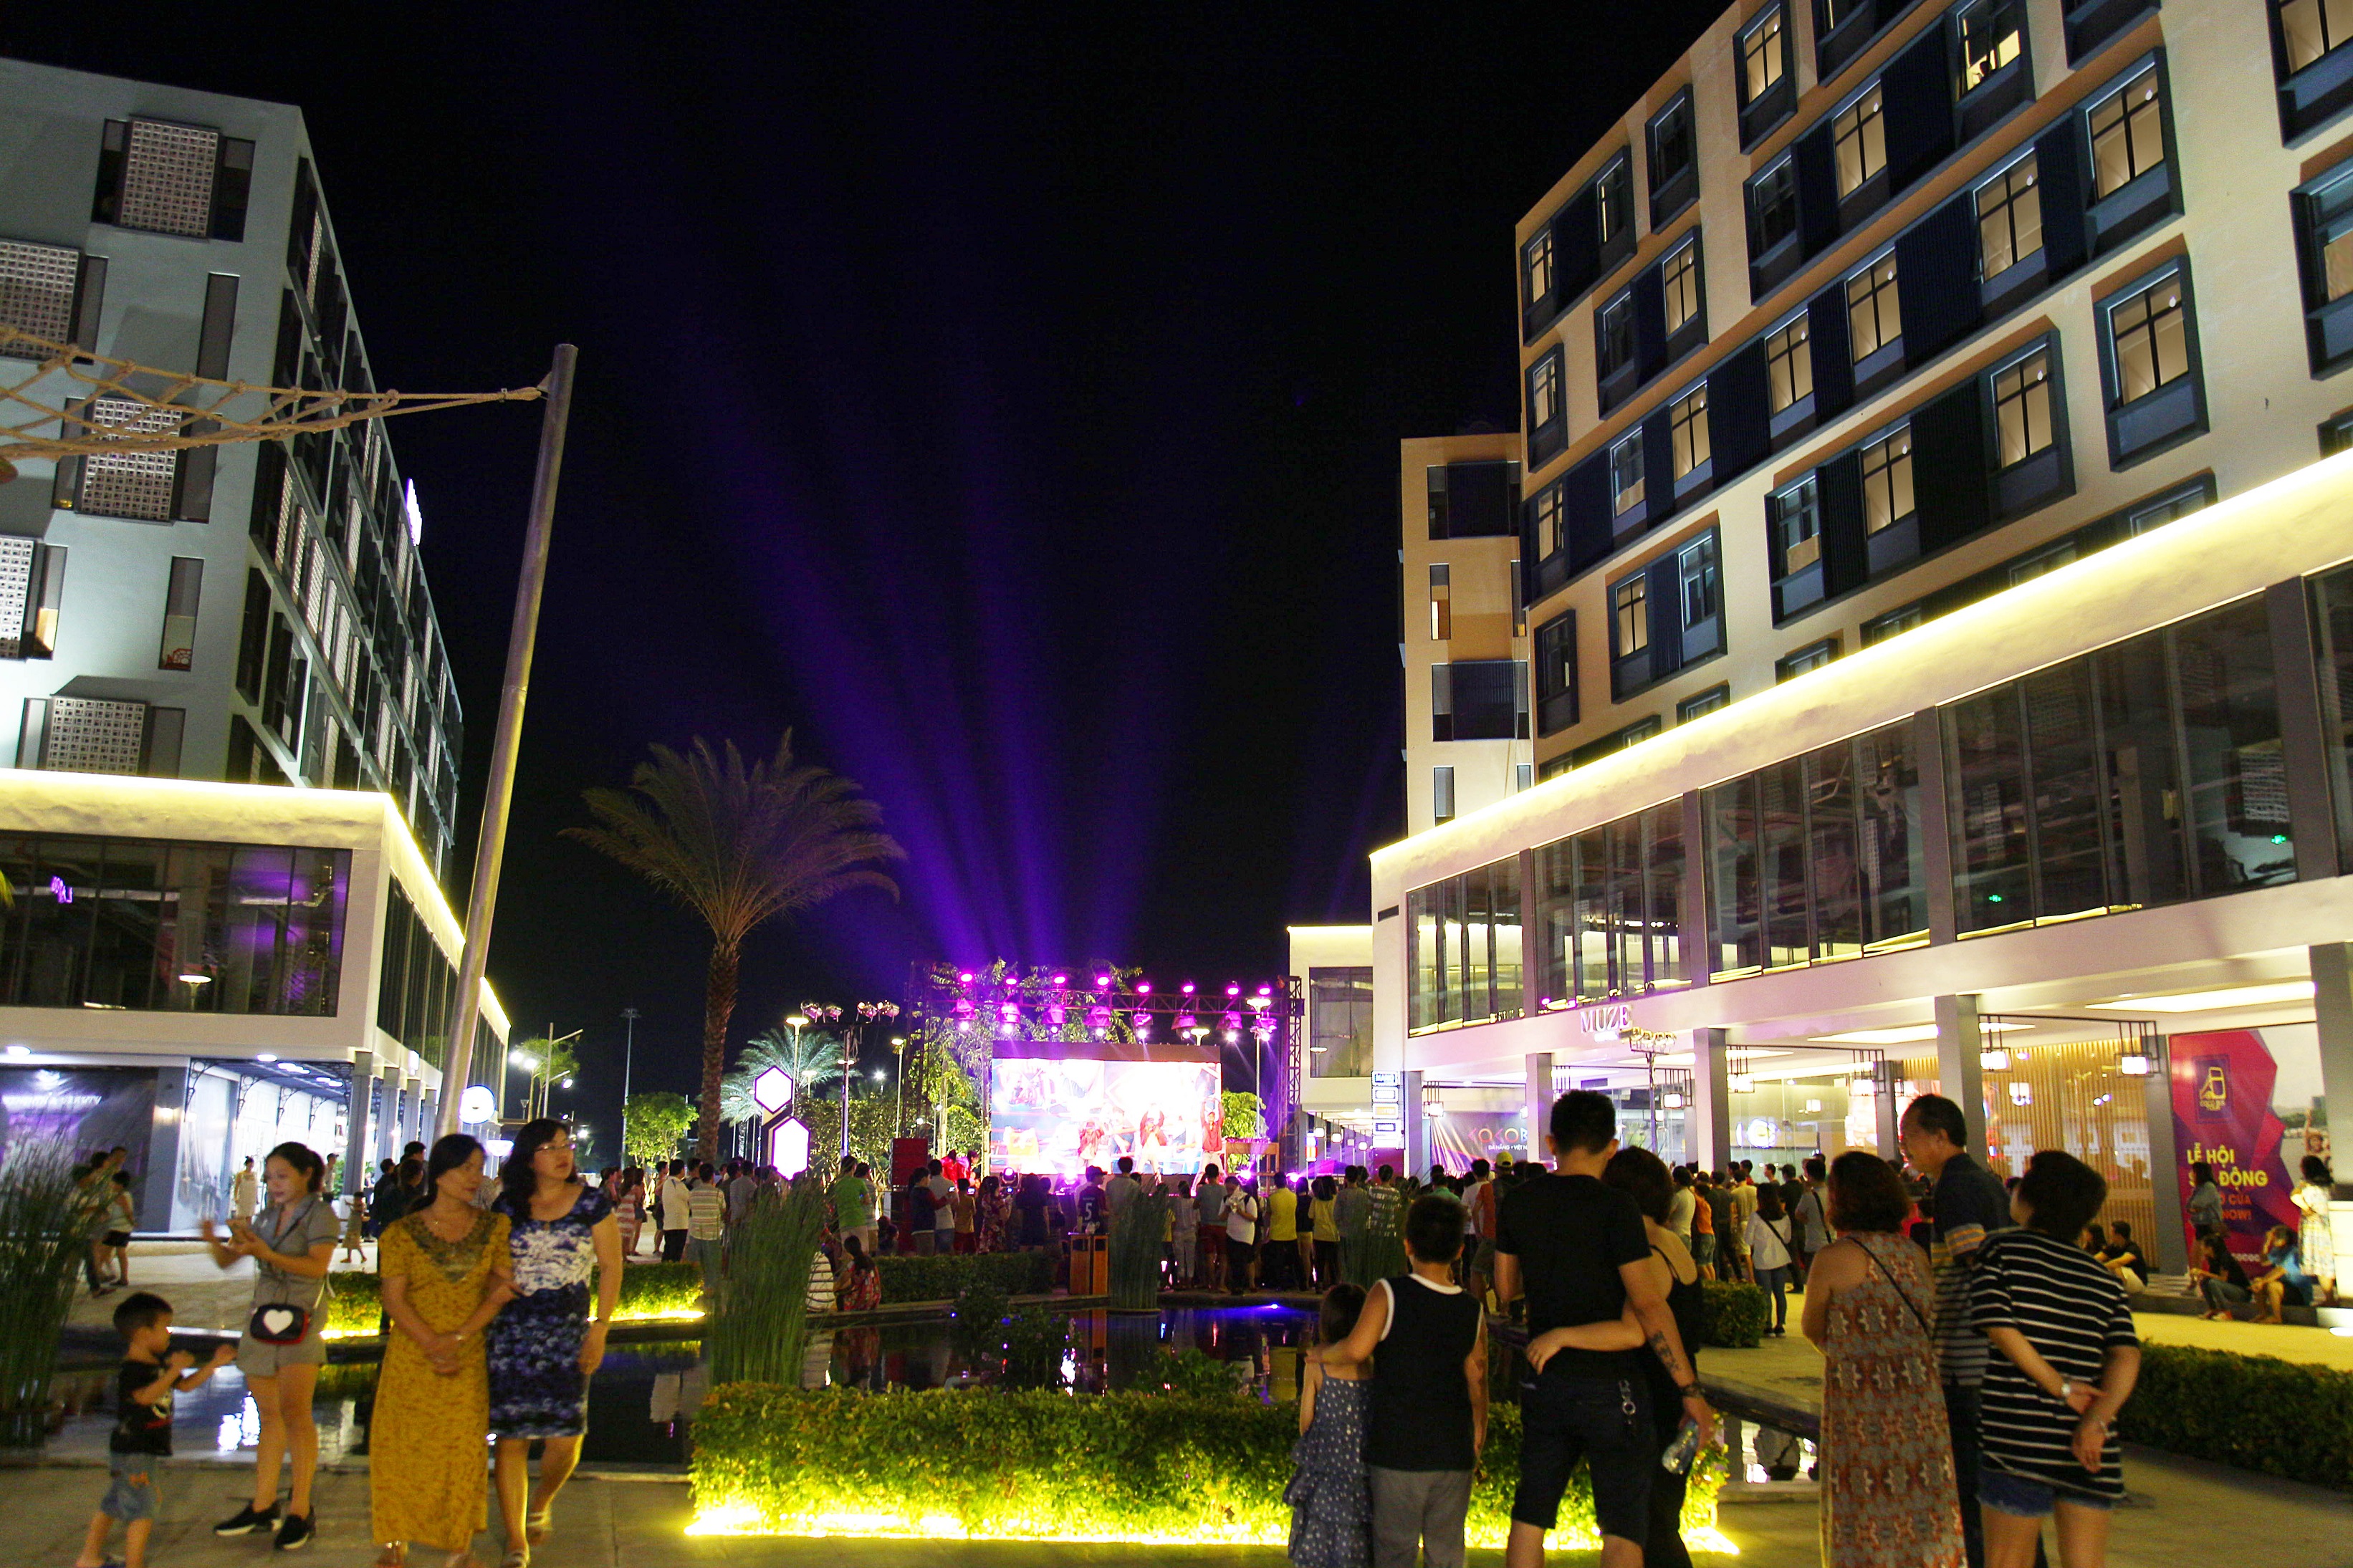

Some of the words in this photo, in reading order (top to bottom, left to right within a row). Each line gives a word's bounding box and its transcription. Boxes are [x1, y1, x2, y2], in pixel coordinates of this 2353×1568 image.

[1580, 1004, 1631, 1033] MUZE
[1467, 1127, 1528, 1143] COCOB
[2206, 1145, 2235, 1168] HỘI
[2218, 1166, 2268, 1191] ĐỘNG
[1084, 1203, 1093, 1221] 5
